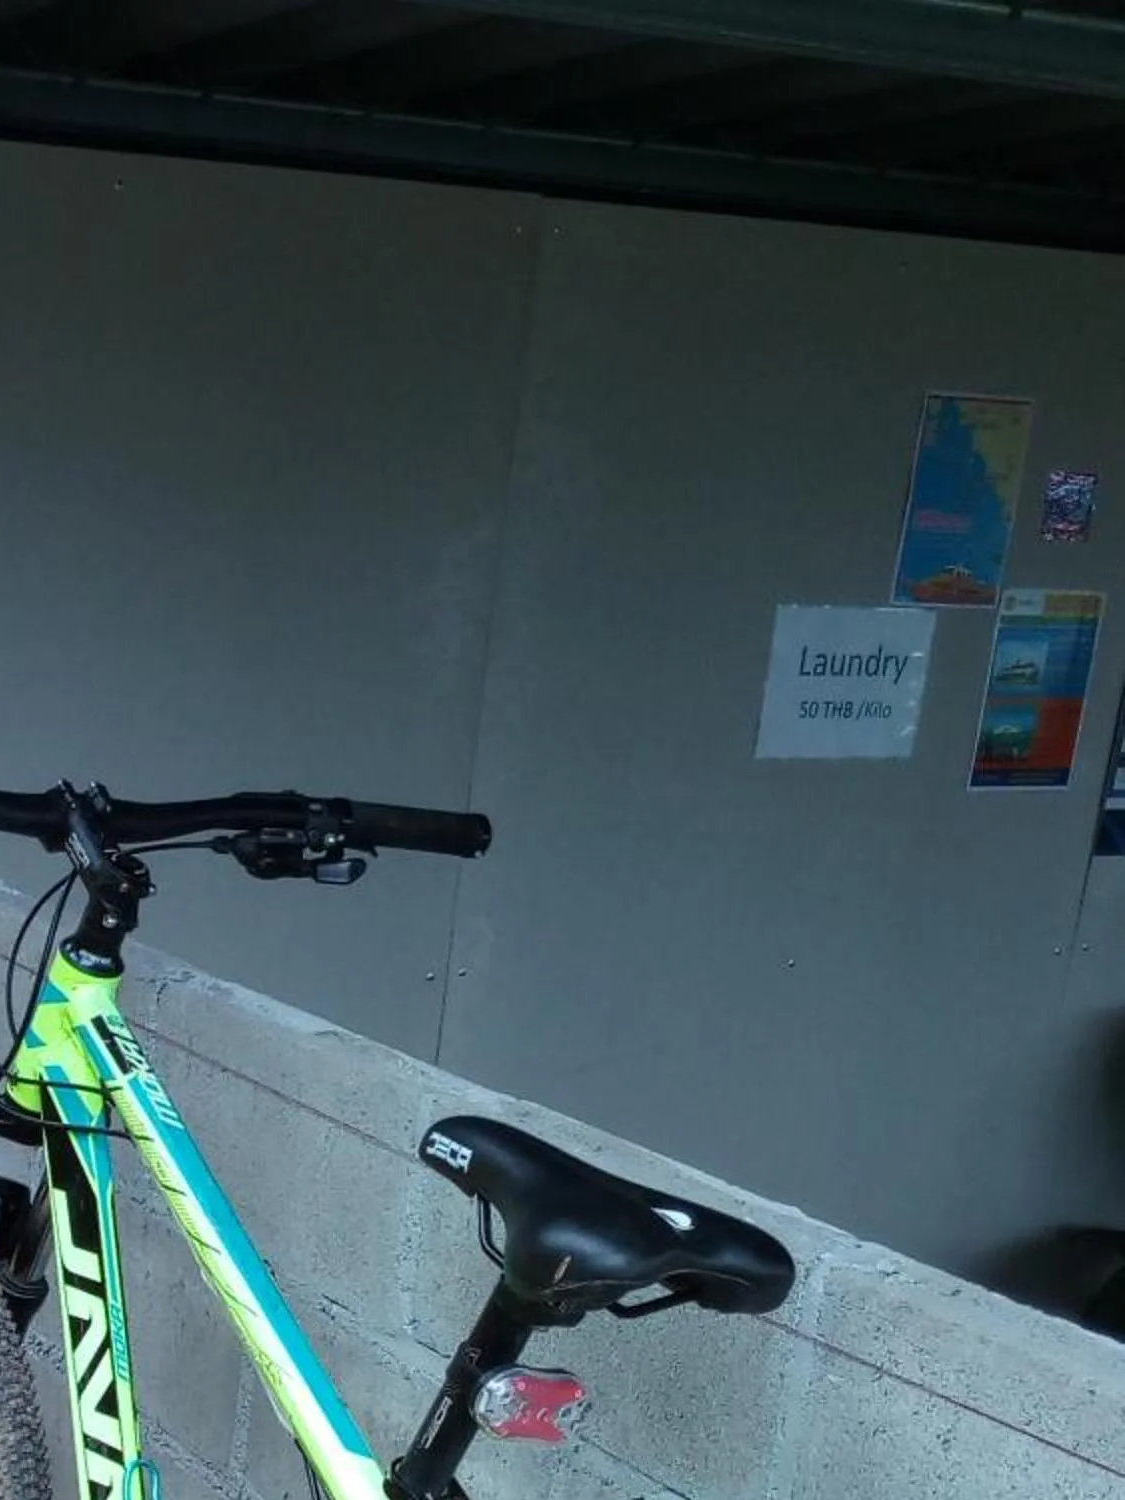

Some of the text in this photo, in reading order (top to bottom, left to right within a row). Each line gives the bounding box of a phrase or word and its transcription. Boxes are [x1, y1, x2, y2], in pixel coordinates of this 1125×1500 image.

[798, 644, 909, 685] Laundry
[798, 701, 820, 719] 50
[822, 701, 854, 719] THB
